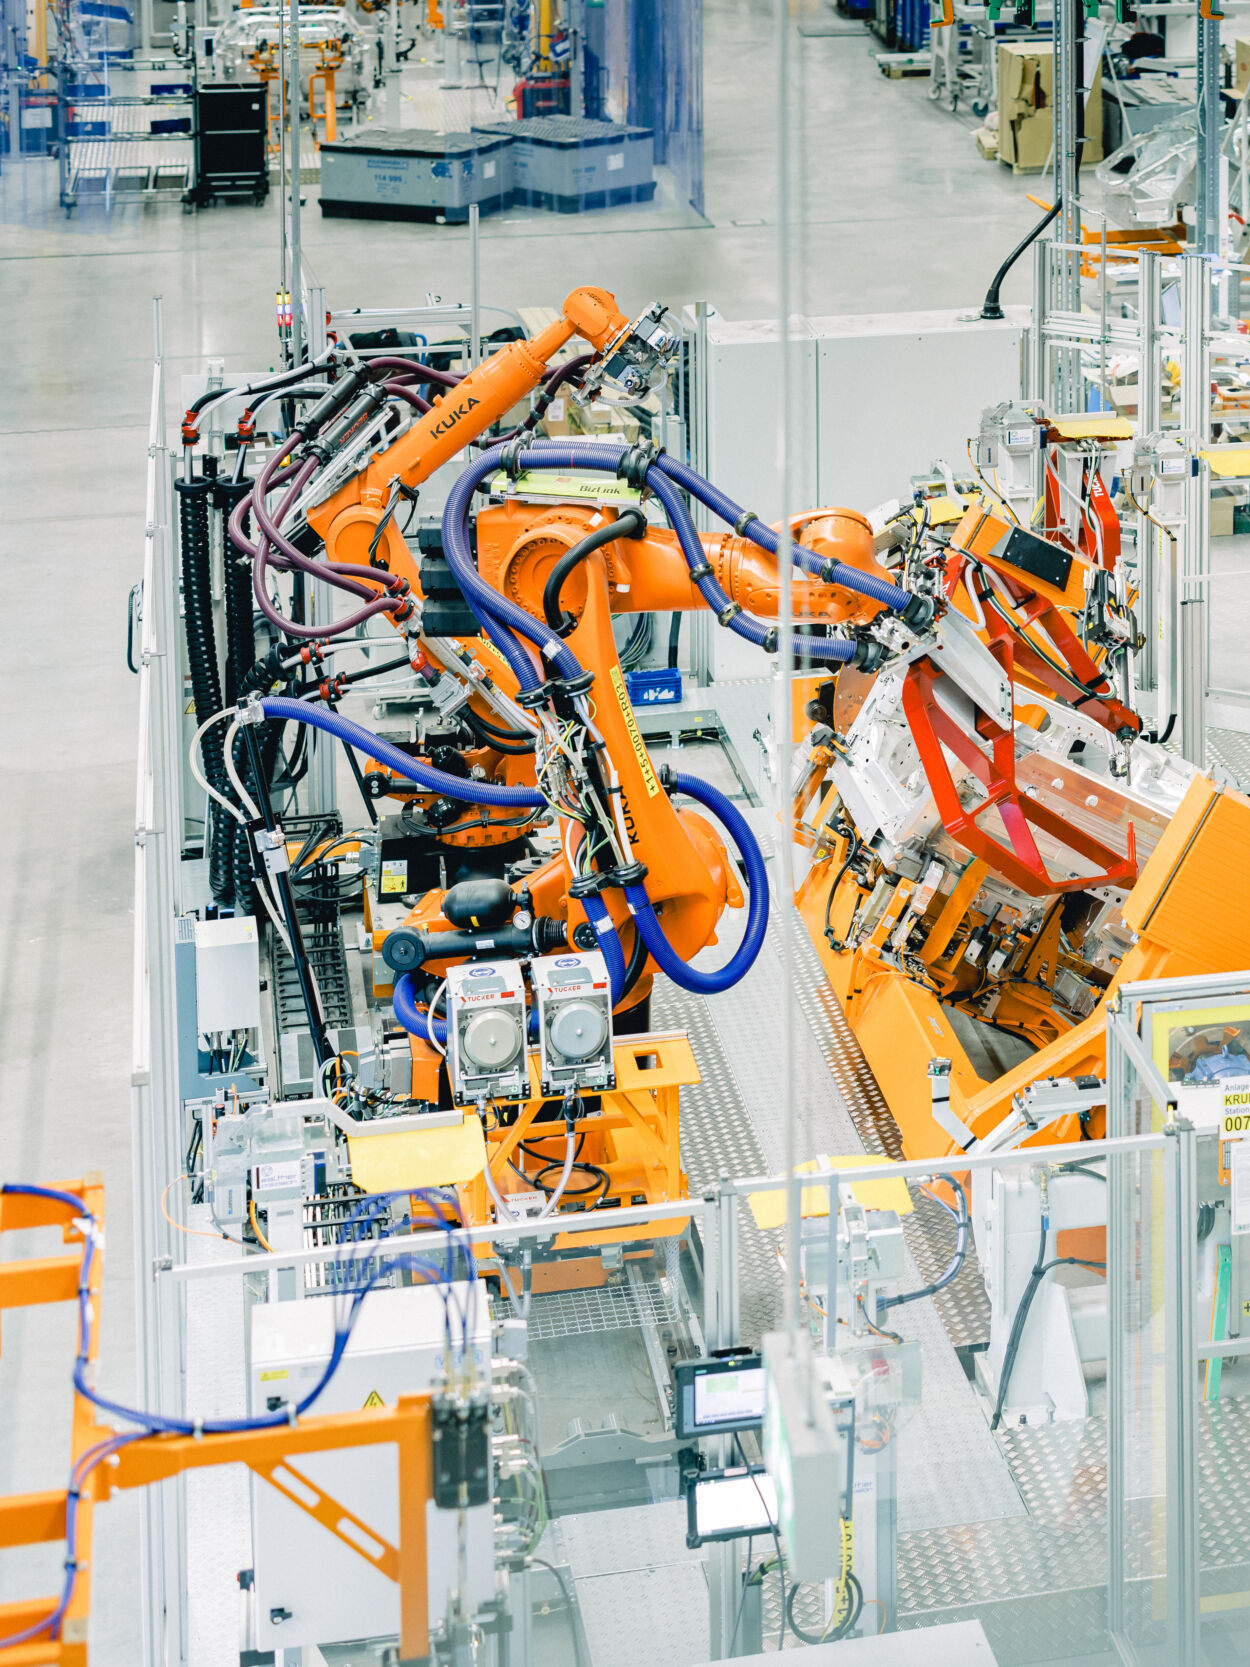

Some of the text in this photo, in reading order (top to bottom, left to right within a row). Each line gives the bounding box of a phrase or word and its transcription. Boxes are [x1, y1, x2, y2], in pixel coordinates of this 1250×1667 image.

[429, 396, 481, 440] KUKA
[579, 485, 620, 495] BizLink
[616, 682, 656, 793] +1+5+0070+R03
[555, 985, 581, 993] TUCKER
[468, 994, 495, 1002] TUCKER
[1225, 1083, 1249, 1092] Anlage
[1225, 1106, 1250, 1115] Station
